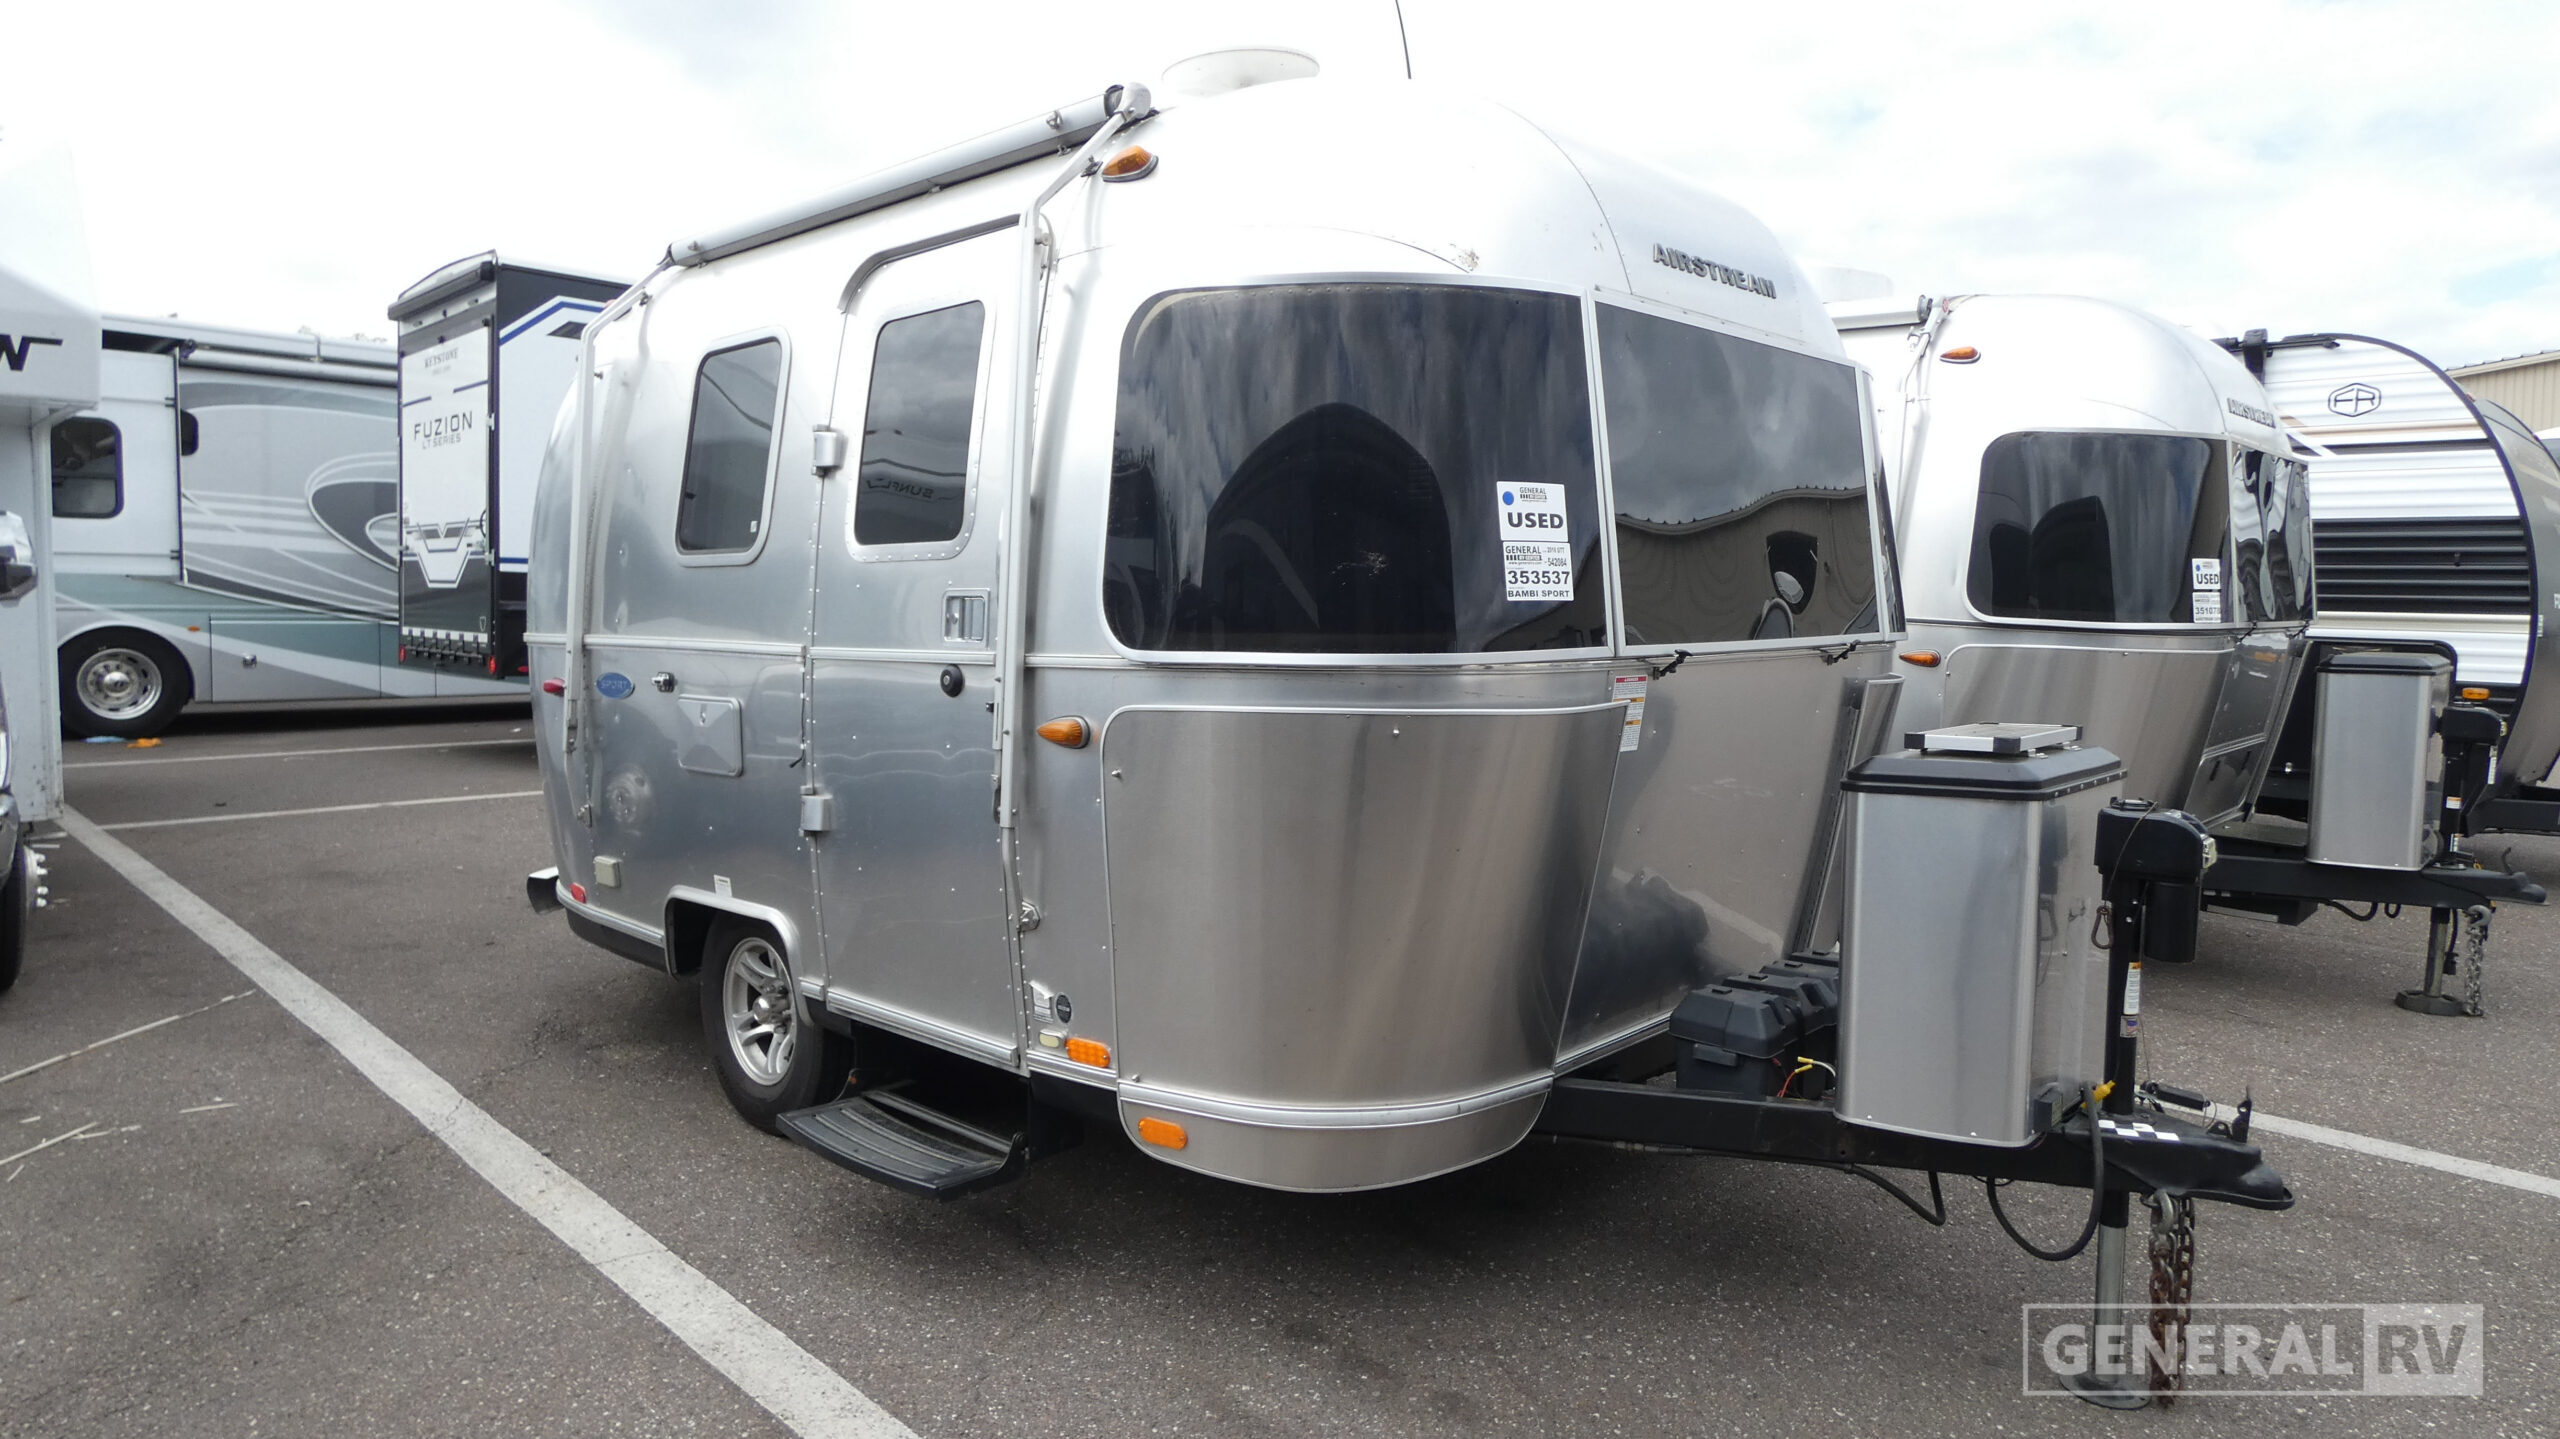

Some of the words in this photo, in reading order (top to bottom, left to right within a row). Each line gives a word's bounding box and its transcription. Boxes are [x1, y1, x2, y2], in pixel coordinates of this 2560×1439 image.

[1653, 243, 1777, 299] AIRSTREAM
[414, 410, 473, 441] FUZION
[422, 439, 431, 450] LT
[432, 433, 462, 448] SERIES
[1519, 487, 1547, 495] GENERAL
[1507, 511, 1564, 529] USED
[1505, 545, 1541, 554] GENERAL
[1507, 570, 1571, 585] 353537
[2196, 573, 2220, 585] USED
[1507, 589, 1539, 598] BAMBI
[1541, 589, 1570, 598] SPORT
[601, 680, 629, 689] SPORT
